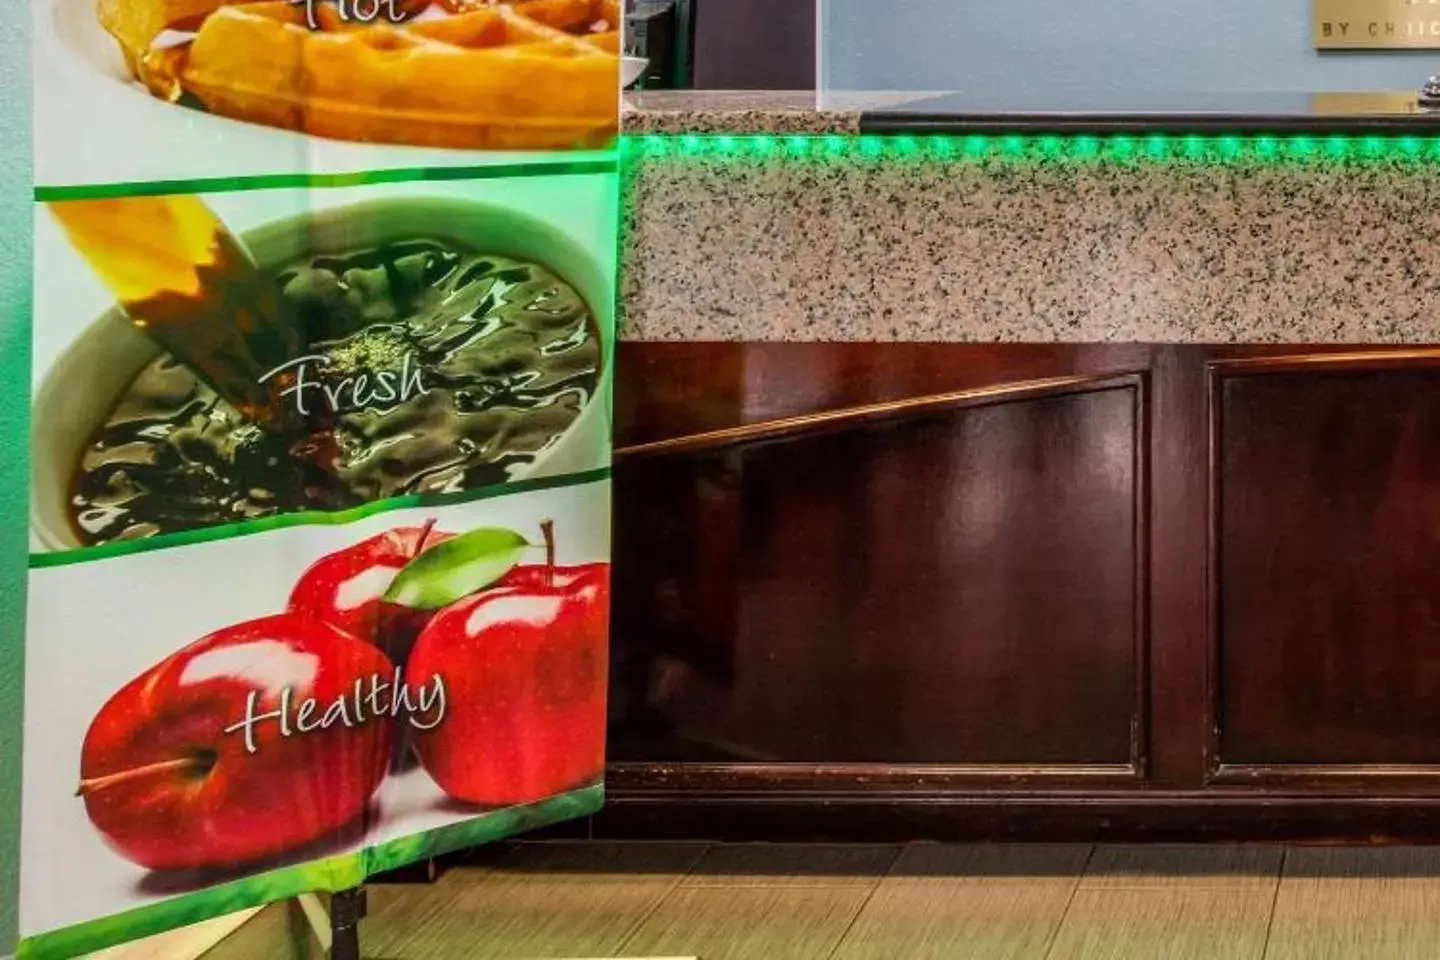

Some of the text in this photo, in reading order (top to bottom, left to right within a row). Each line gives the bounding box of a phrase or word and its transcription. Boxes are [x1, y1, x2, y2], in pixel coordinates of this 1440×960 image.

[1322, 21, 1350, 37] BY
[258, 350, 431, 417] Fresh
[224, 666, 447, 753] Healthy
